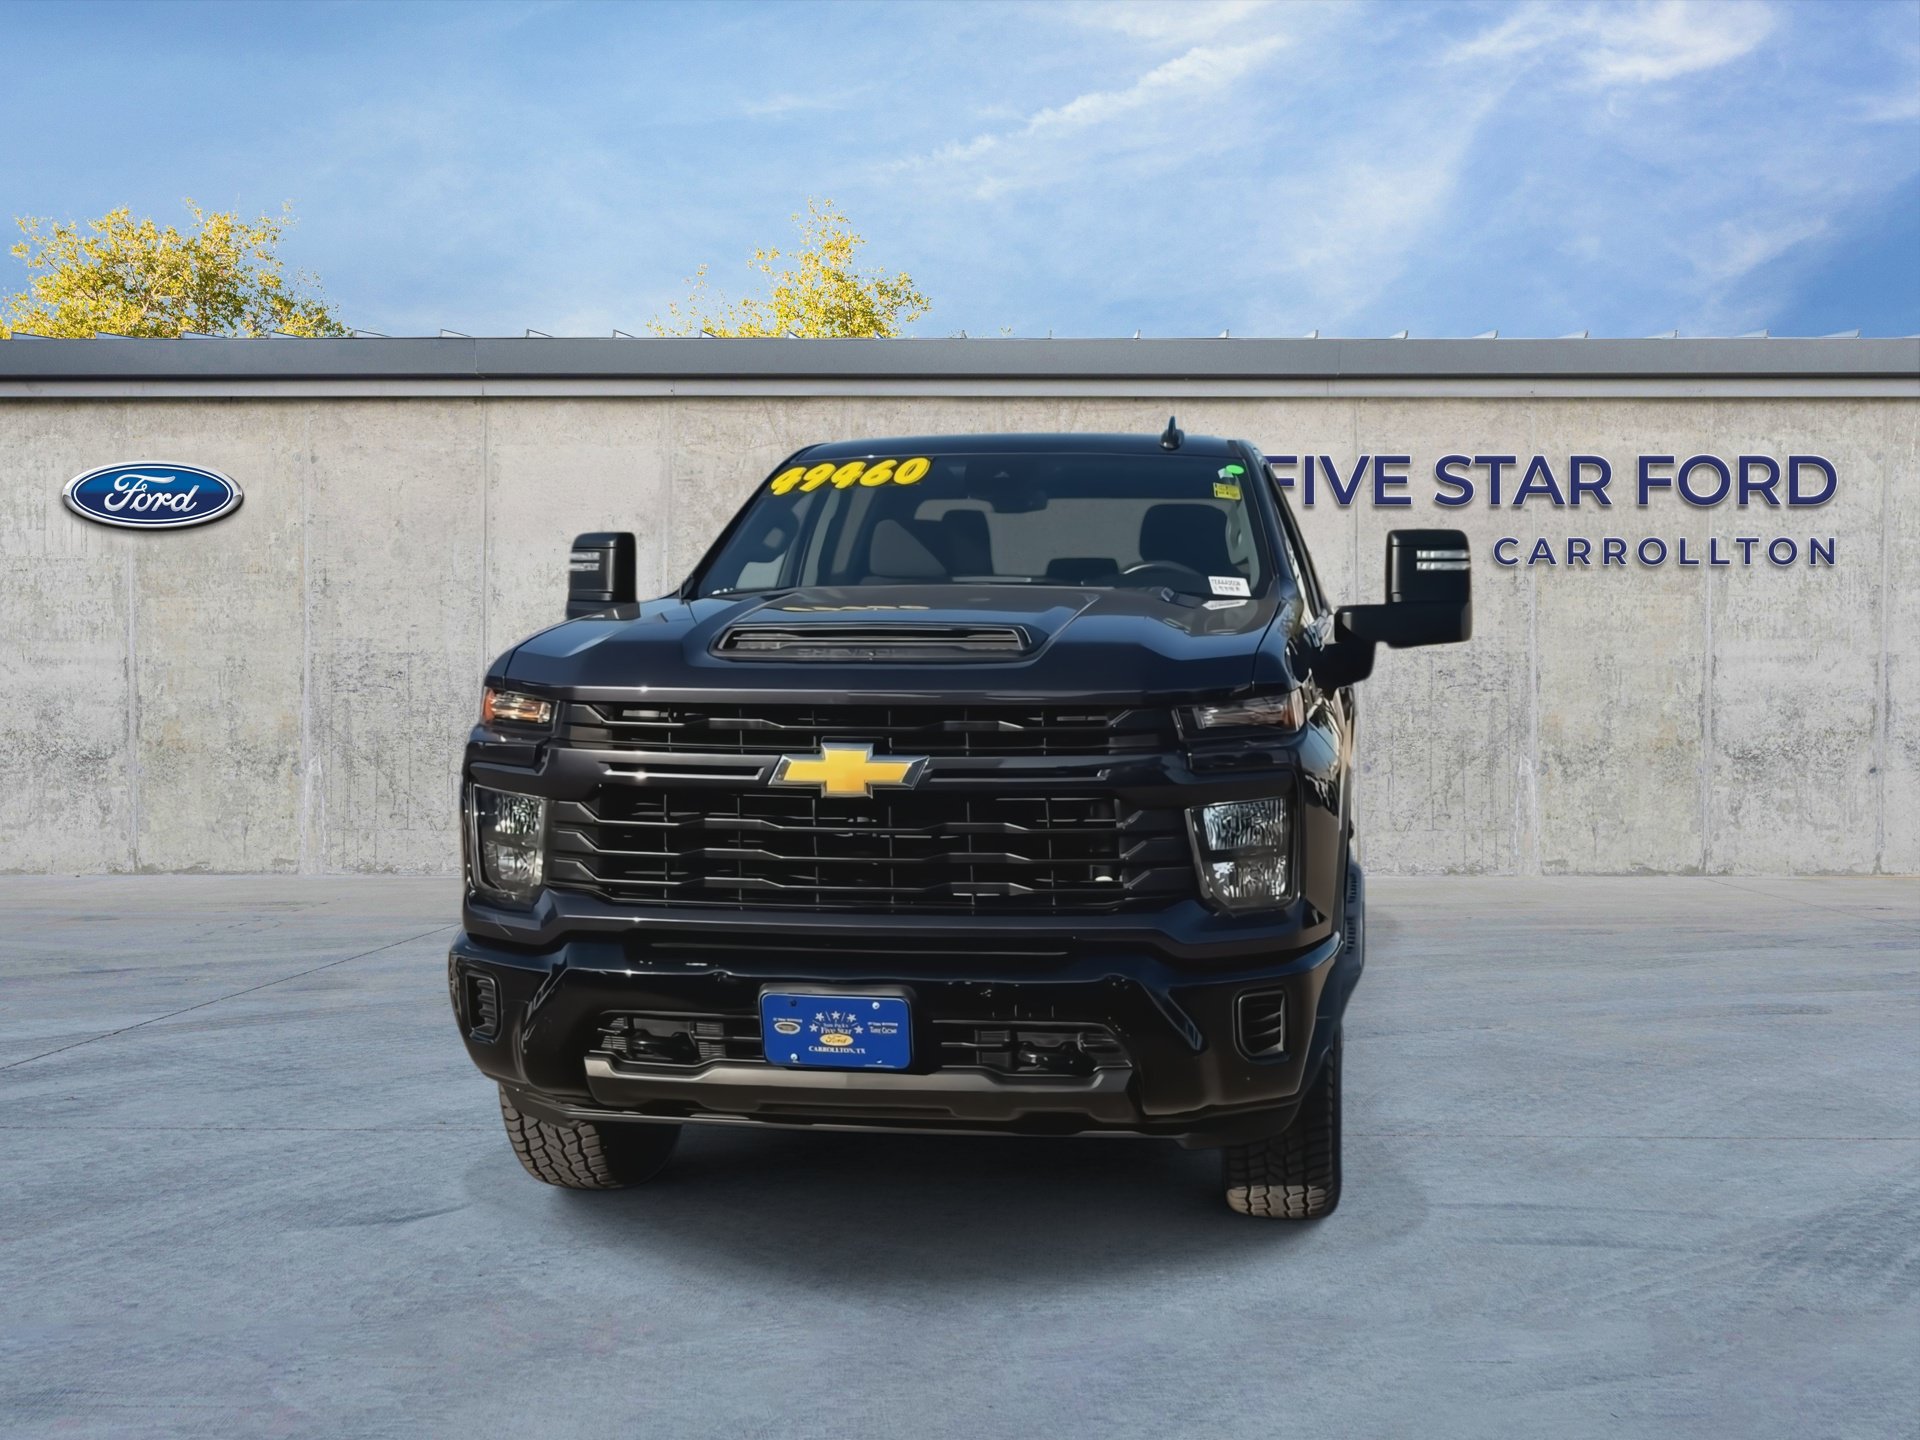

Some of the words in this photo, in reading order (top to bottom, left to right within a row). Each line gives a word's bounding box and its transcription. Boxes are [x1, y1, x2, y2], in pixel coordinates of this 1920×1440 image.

[104, 473, 200, 512] Ford
[771, 457, 931, 496] 49460
[1434, 454, 1613, 506] STAR
[1637, 454, 1838, 506] FORD
[1493, 537, 1835, 566] CARROLLTON
